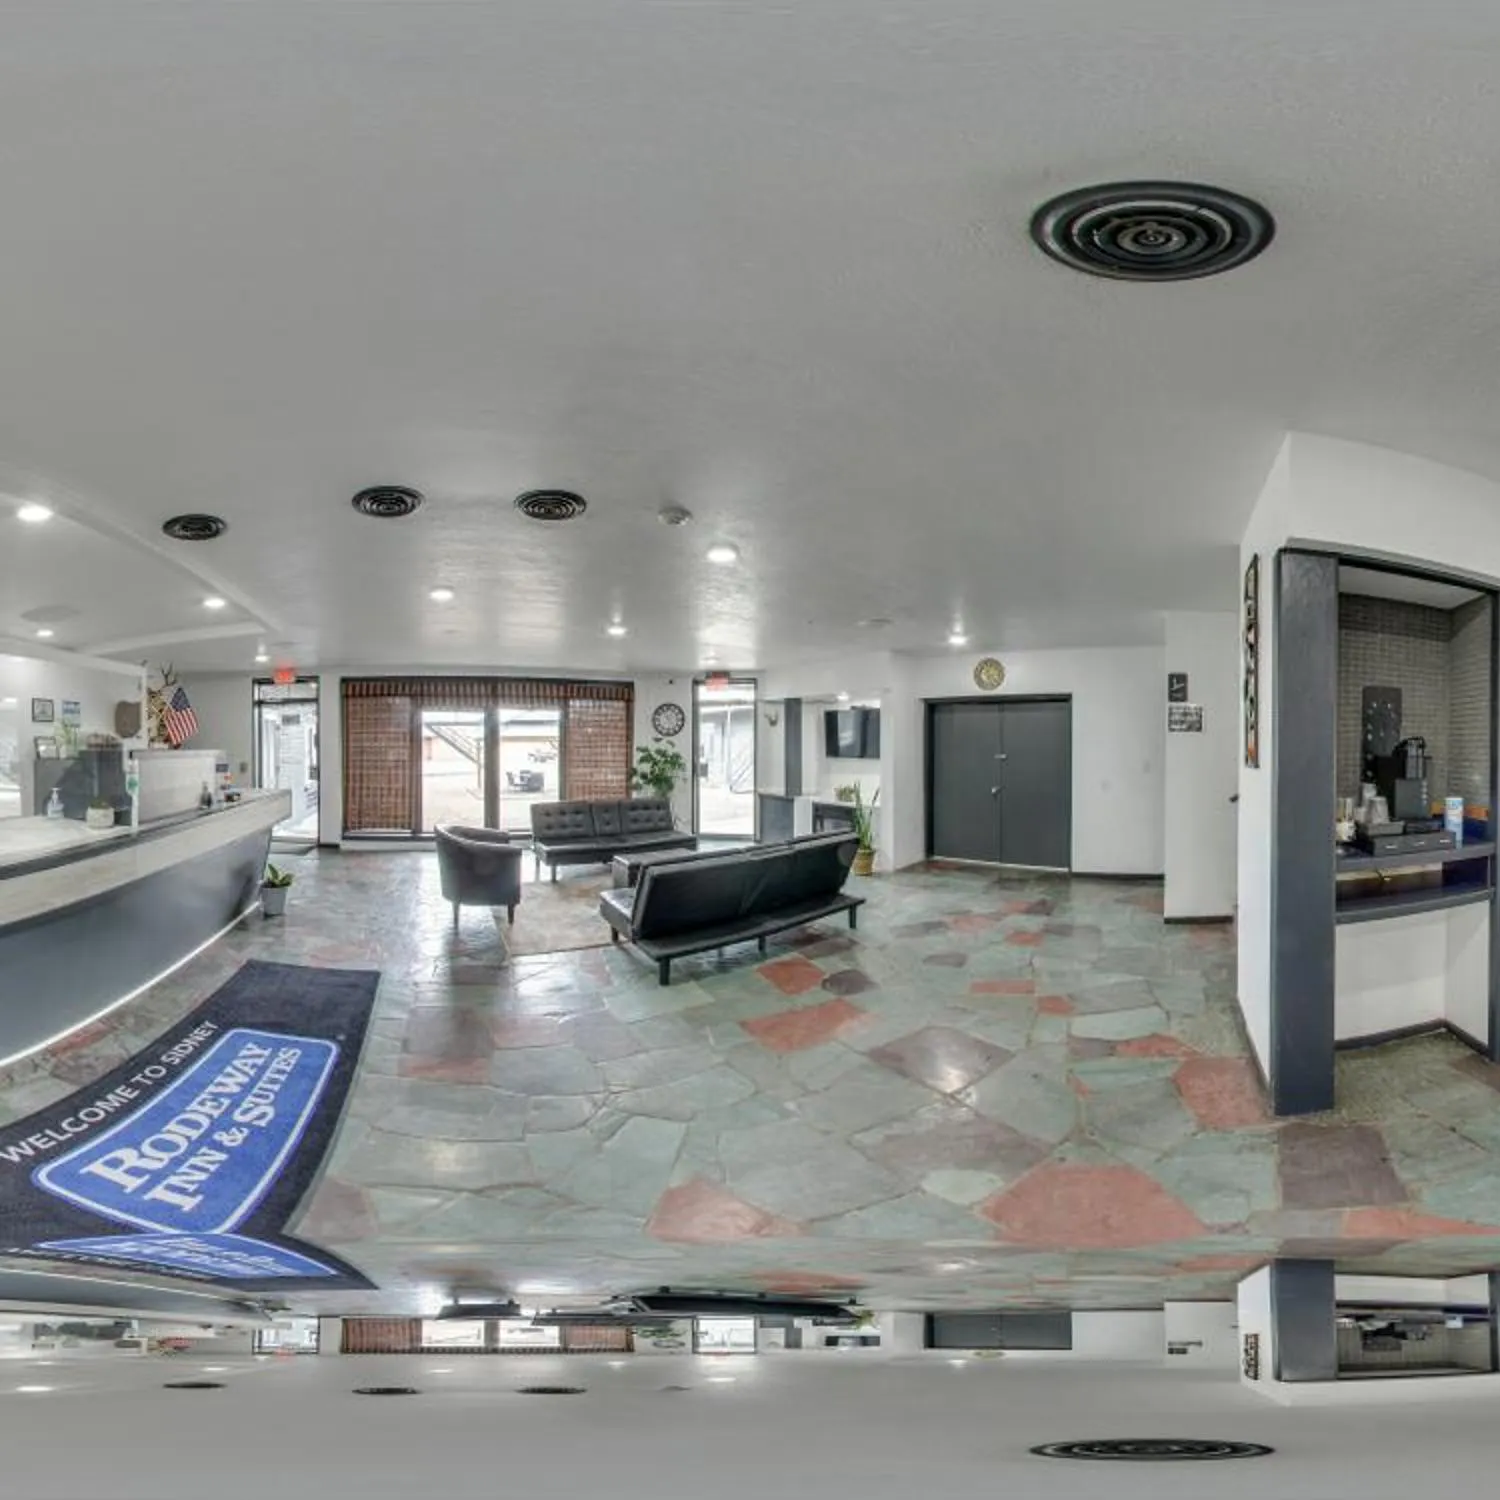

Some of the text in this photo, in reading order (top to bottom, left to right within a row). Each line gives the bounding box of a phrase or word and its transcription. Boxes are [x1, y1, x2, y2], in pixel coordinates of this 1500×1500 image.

[0, 1020, 218, 1162] WELCOME TO SIDNEY
[79, 1042, 273, 1194] RODEWAY
[142, 1046, 302, 1212] INN & SUITES
